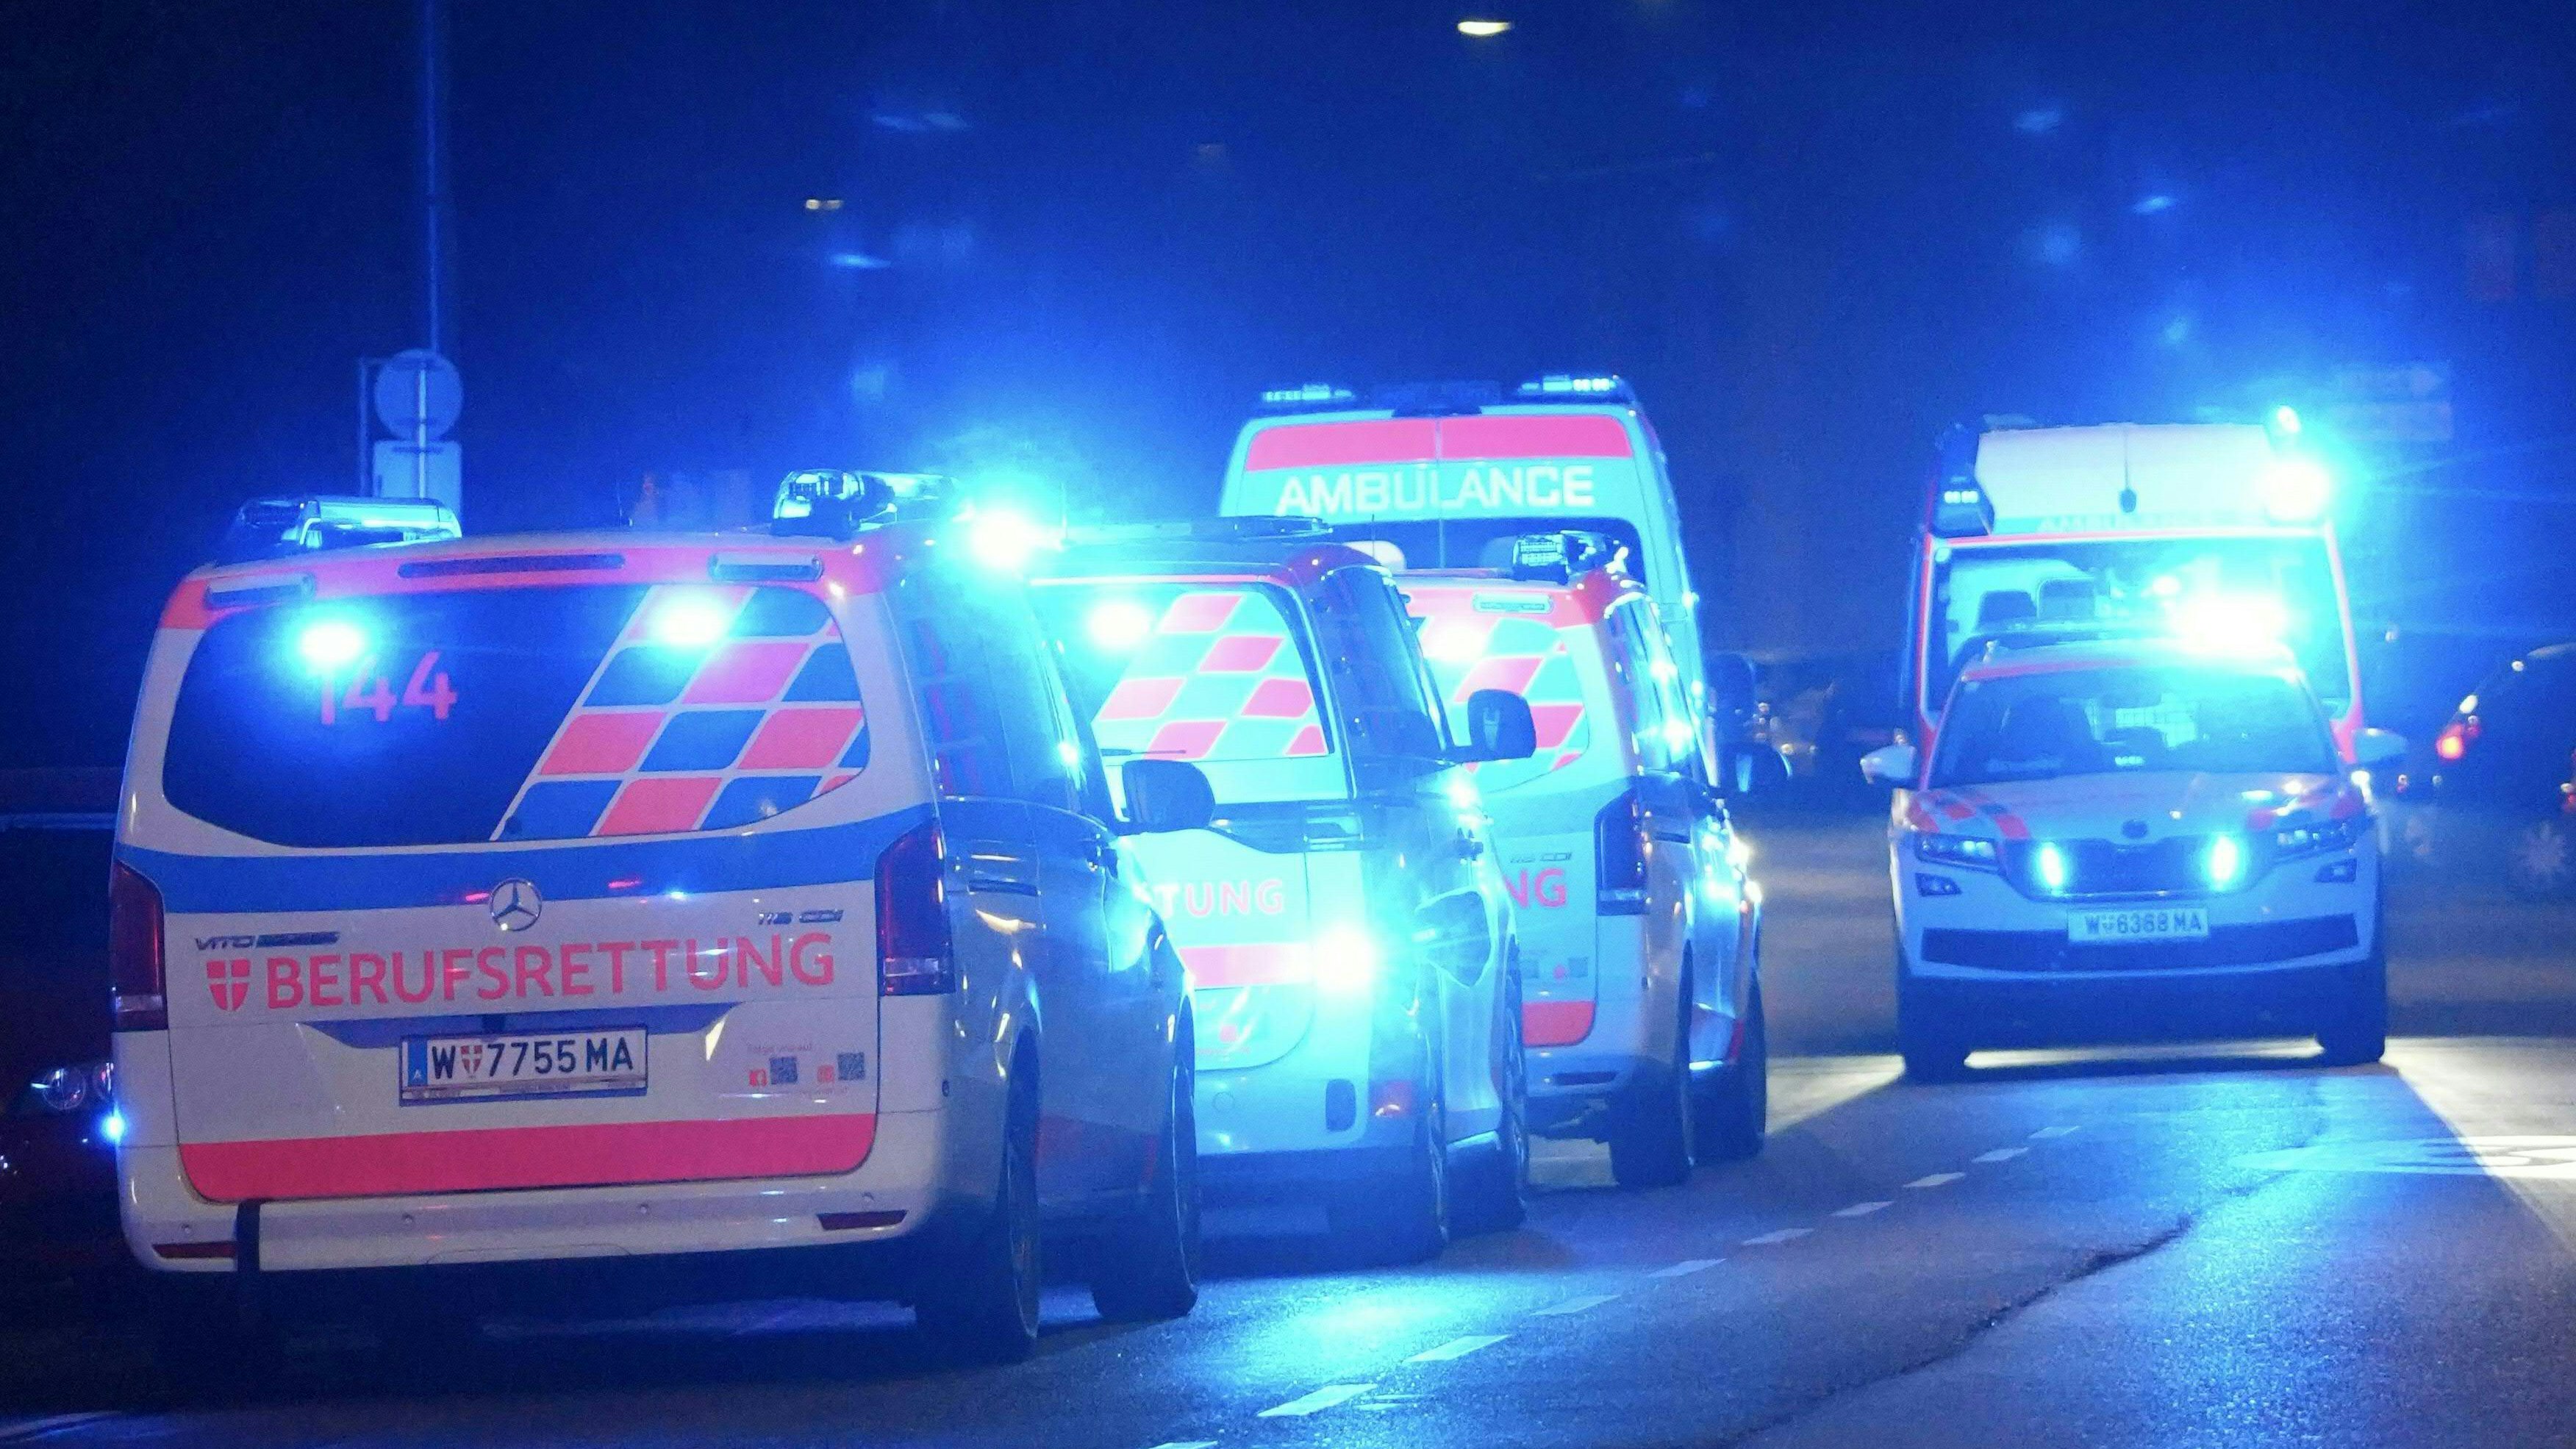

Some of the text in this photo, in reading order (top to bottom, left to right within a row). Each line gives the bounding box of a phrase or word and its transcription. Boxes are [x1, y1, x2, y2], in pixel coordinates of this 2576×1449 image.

[1275, 465, 1595, 516] AMBULANCE
[321, 649, 458, 725] 144
[194, 935, 256, 951] VITO
[2084, 915, 2100, 934] W
[2174, 911, 2202, 931] MA
[266, 932, 835, 1010] BERUFSRETTUNG
[432, 1037, 634, 1079] W 7755 MA
